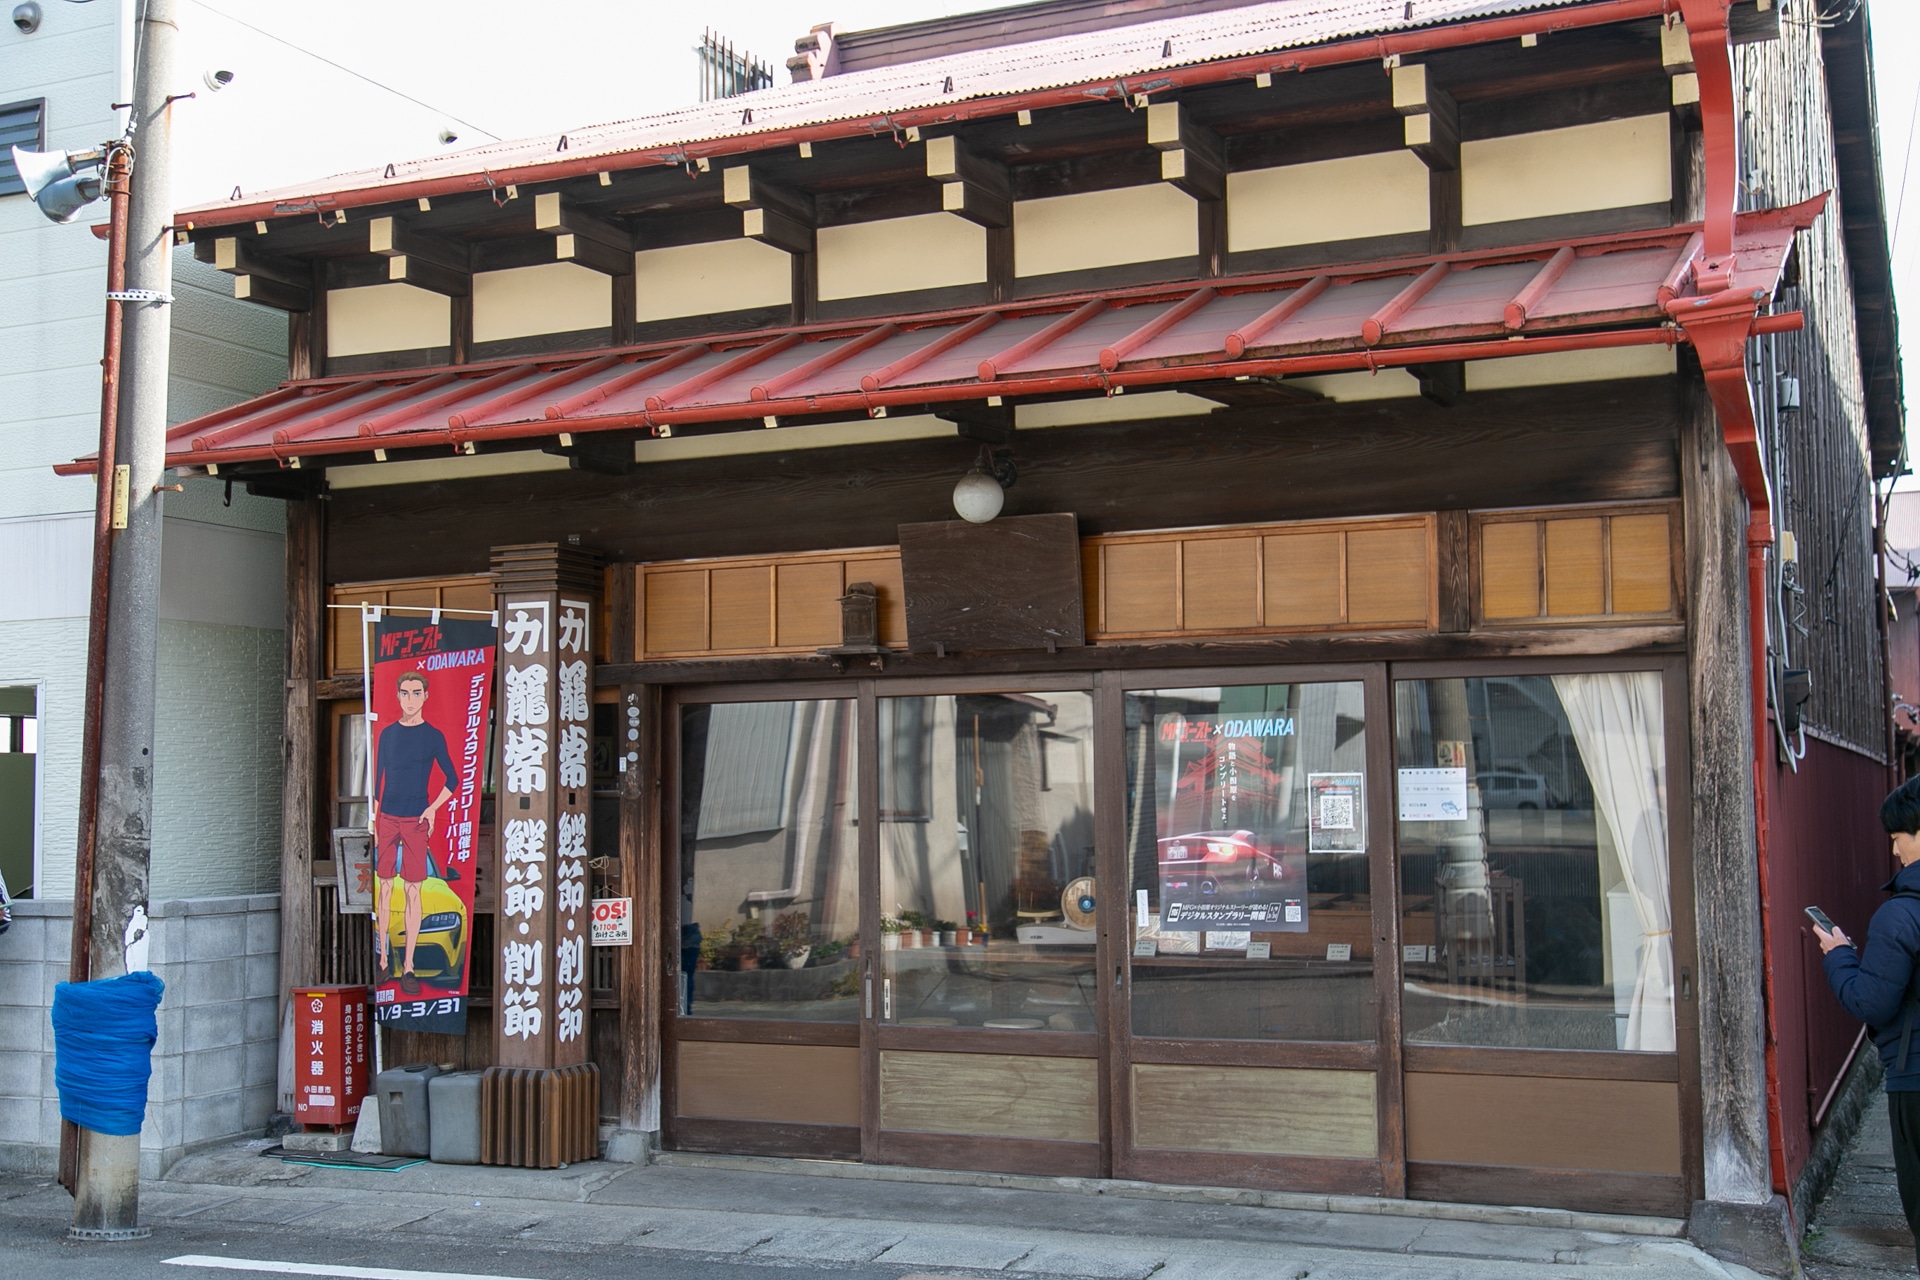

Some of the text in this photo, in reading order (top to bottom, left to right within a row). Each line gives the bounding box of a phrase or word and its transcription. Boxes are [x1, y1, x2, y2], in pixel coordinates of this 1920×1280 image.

[380, 625, 442, 657] MFゴースト
[427, 648, 485, 671] ODAWARA
[1223, 718, 1295, 738] ODAWARA
[457, 672, 485, 863] デジタルスタンプラリー開催中
[310, 1019, 324, 1076] 消火器
[304, 1085, 332, 1094] 小田原市
[297, 1103, 308, 1112] NO
